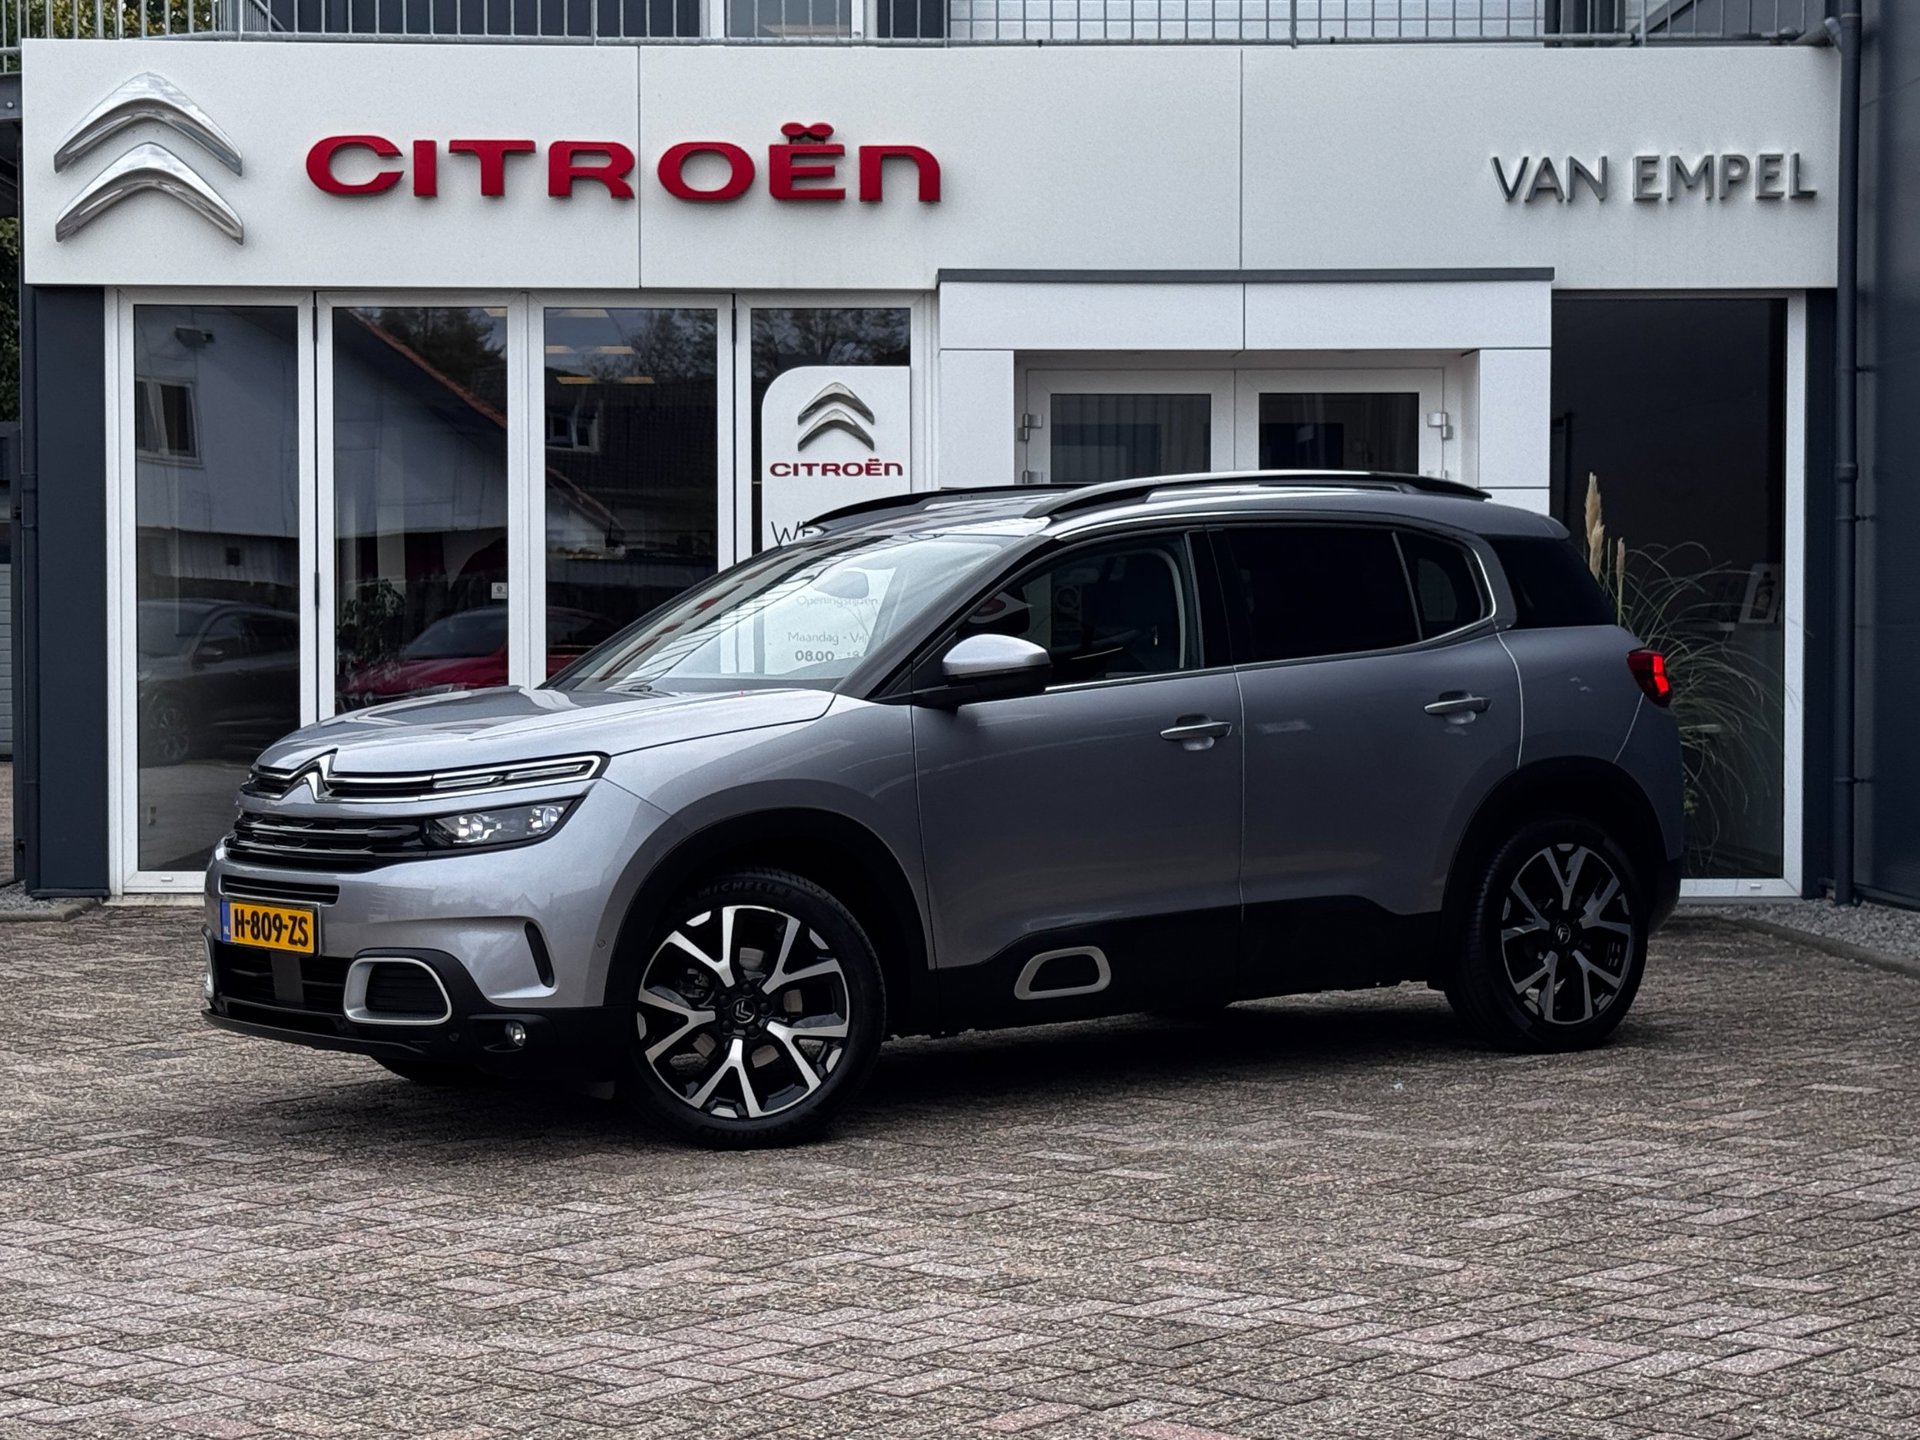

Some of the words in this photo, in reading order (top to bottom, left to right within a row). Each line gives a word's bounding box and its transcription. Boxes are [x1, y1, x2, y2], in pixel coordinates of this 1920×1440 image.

[1490, 155, 1608, 202] VAN
[1632, 153, 1817, 201] EMPEL
[787, 631, 839, 646] Maandag
[795, 649, 834, 661] 08.00
[234, 908, 308, 947] H-809-ZS
